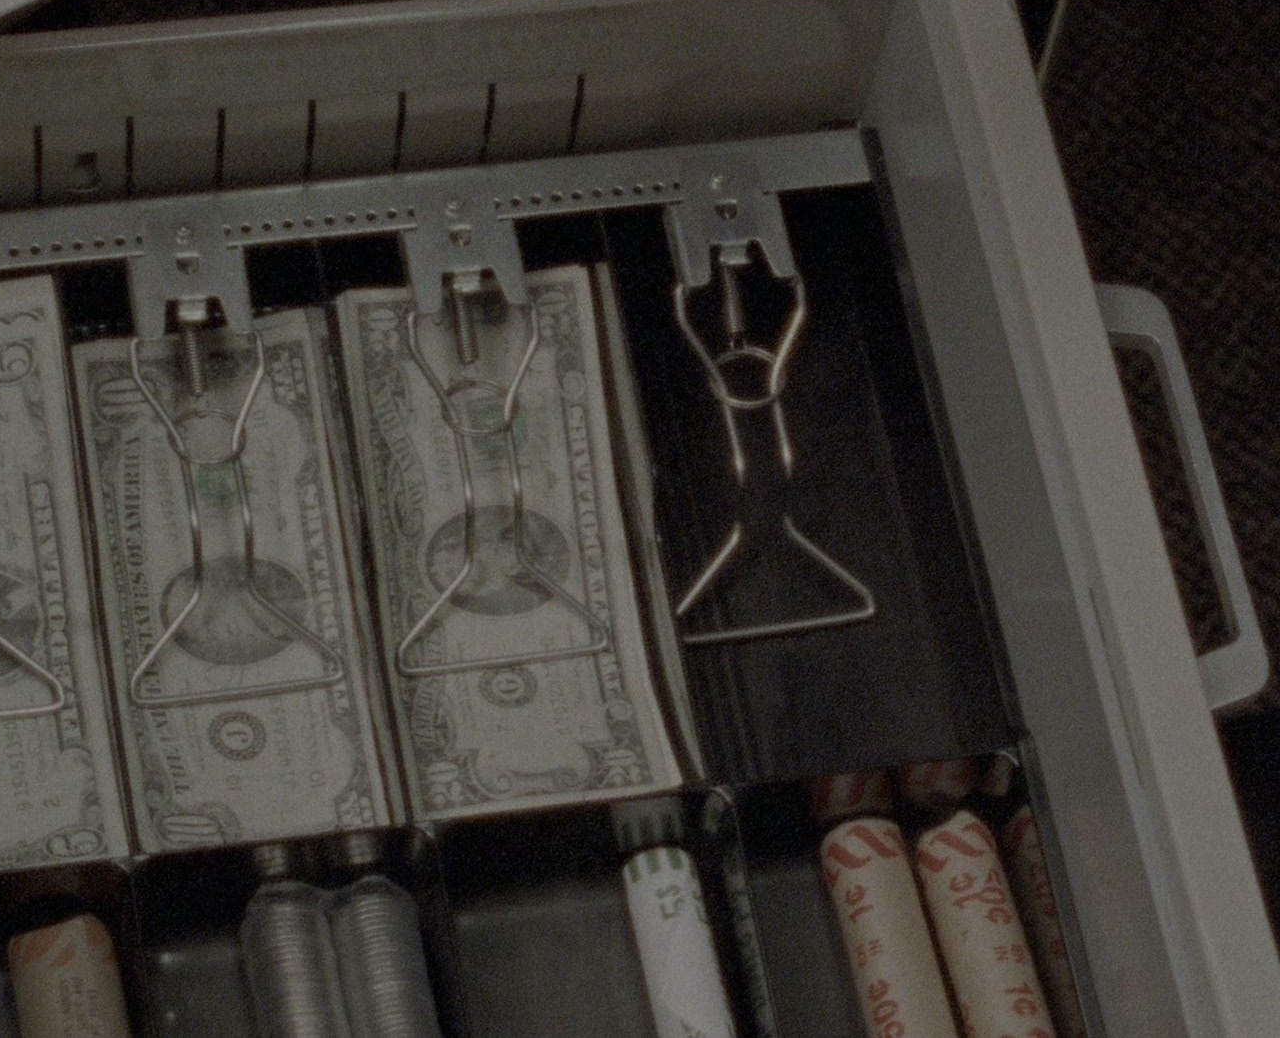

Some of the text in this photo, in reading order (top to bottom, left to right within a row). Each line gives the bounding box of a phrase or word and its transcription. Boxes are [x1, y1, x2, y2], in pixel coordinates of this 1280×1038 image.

[369, 308, 401, 352] 20
[536, 291, 570, 338] 20
[99, 378, 156, 414] 10
[122, 436, 141, 533] AMERICA
[570, 404, 604, 570] DOLLARS
[32, 482, 69, 660] DOLLARS
[126, 543, 143, 566] OF
[300, 483, 337, 640] DOLLARS
[426, 761, 462, 806] 20
[604, 749, 641, 783] 20
[45, 829, 102, 856] 5
